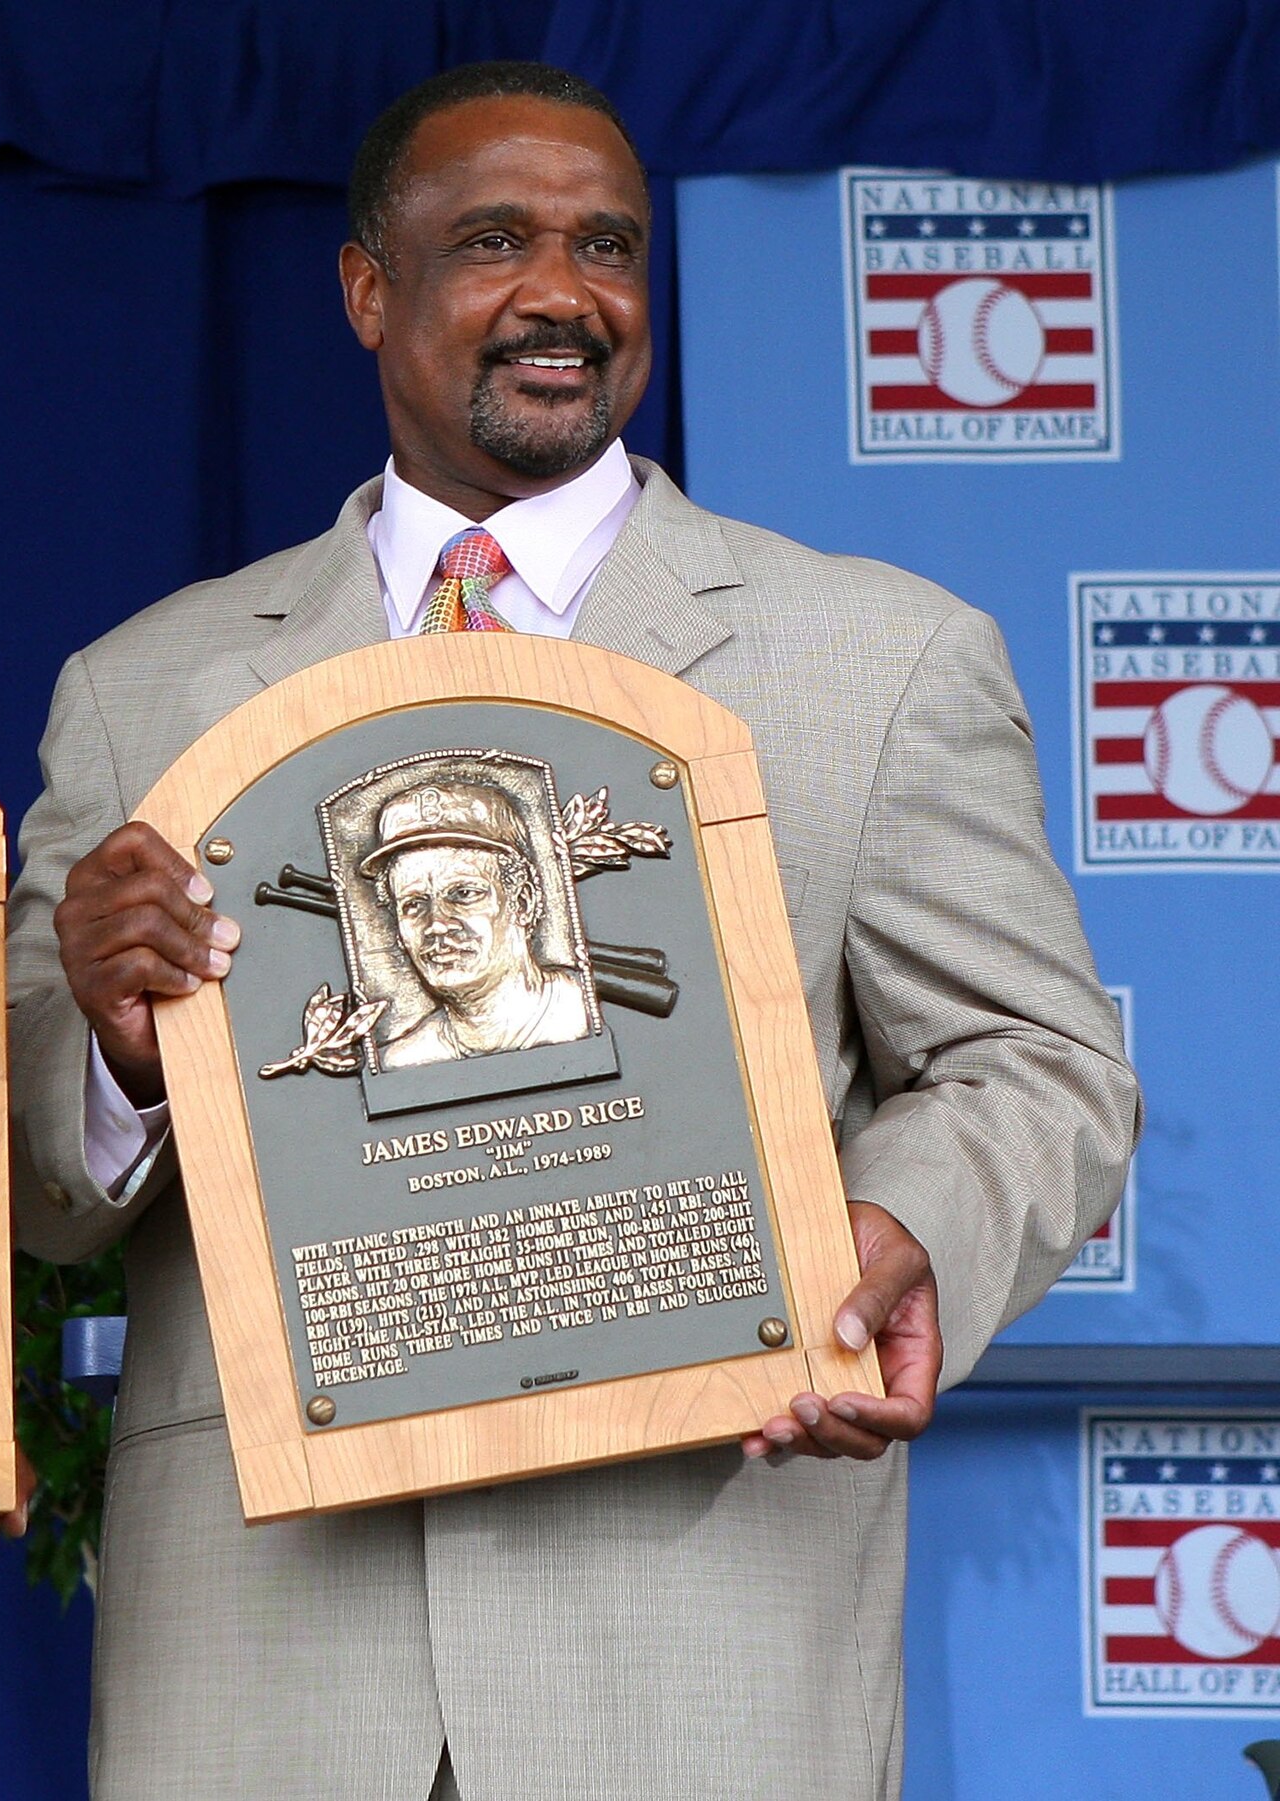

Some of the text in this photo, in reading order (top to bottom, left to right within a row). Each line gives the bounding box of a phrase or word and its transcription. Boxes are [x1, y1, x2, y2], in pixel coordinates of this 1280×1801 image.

[862, 184, 1090, 211] NATIONAL
[865, 246, 1094, 270] BASEBALL
[871, 414, 1098, 441] HALL OF FAME
[1091, 591, 1280, 618] NATION
[1093, 653, 1280, 677] BASEBA
[1096, 826, 1176, 849] HALL
[1187, 826, 1228, 849] OF
[362, 1097, 645, 1165] JAMES EDWARD RICE
[408, 1144, 612, 1192] BOSTON, A.L., 1974-1989
[291, 1170, 747, 1262] WITH TITANIC STRENGTH AND AN INNATE ABILITY TO HIT TO ALL
[295, 1256, 348, 1279] FIELDS,
[352, 1245, 407, 1268] BATTED
[444, 1232, 481, 1251] WITH
[487, 1227, 510, 1245] 382
[515, 1219, 555, 1240] HOME
[560, 1211, 598, 1232] RUNS
[604, 1206, 634, 1224] AND
[678, 1193, 706, 1211] RBI.
[711, 1185, 748, 1205] ONLY
[297, 1271, 352, 1294] PLAYER
[355, 1263, 392, 1283] WITH
[394, 1255, 443, 1277] THREE
[443, 1242, 511, 1268] STRAIGHT
[577, 1225, 613, 1245] RUN,
[667, 1210, 699, 1229] AND
[300, 1216, 755, 1309] SEASONS. HIT 20 OR MORE HOME RUNS 11 TIMES AND TOTALED EIGHT
[306, 1322, 330, 1341] RBI
[378, 1308, 414, 1328] HITS
[451, 1296, 484, 1315] AND
[490, 1291, 510, 1308] AN
[516, 1274, 606, 1304] ASTONISHING
[612, 1269, 635, 1286] 406
[639, 1261, 685, 1282] TOTAL
[687, 1252, 736, 1273] BASES.
[739, 1247, 762, 1264] AN
[354, 1292, 417, 1316] SEASONS.
[418, 1286, 450, 1304] THE
[450, 1281, 479, 1299] 1978
[478, 1276, 508, 1294] A.L.
[509, 1270, 544, 1289] MVP,
[545, 1264, 573, 1282] LED
[575, 1254, 630, 1277] LEAGUE
[631, 1251, 647, 1267] IN
[649, 1244, 690, 1264] HOME
[691, 1237, 728, 1257] RUNS
[309, 1263, 766, 1356] EIGHT-TIME ALL-STAR, LED THE A.L. IN TOTAL BASES FOUR TIMES,
[312, 1278, 768, 1372] HOME RUNS THREE TIMES AND TWICE IN RBI AND SLUGGING
[315, 1358, 408, 1387] PERCENTAGE.
[1103, 1426, 1280, 1451] NATION
[1103, 1489, 1277, 1515] BASEBA
[1105, 1669, 1188, 1693] HALL
[1199, 1669, 1240, 1693] OF
